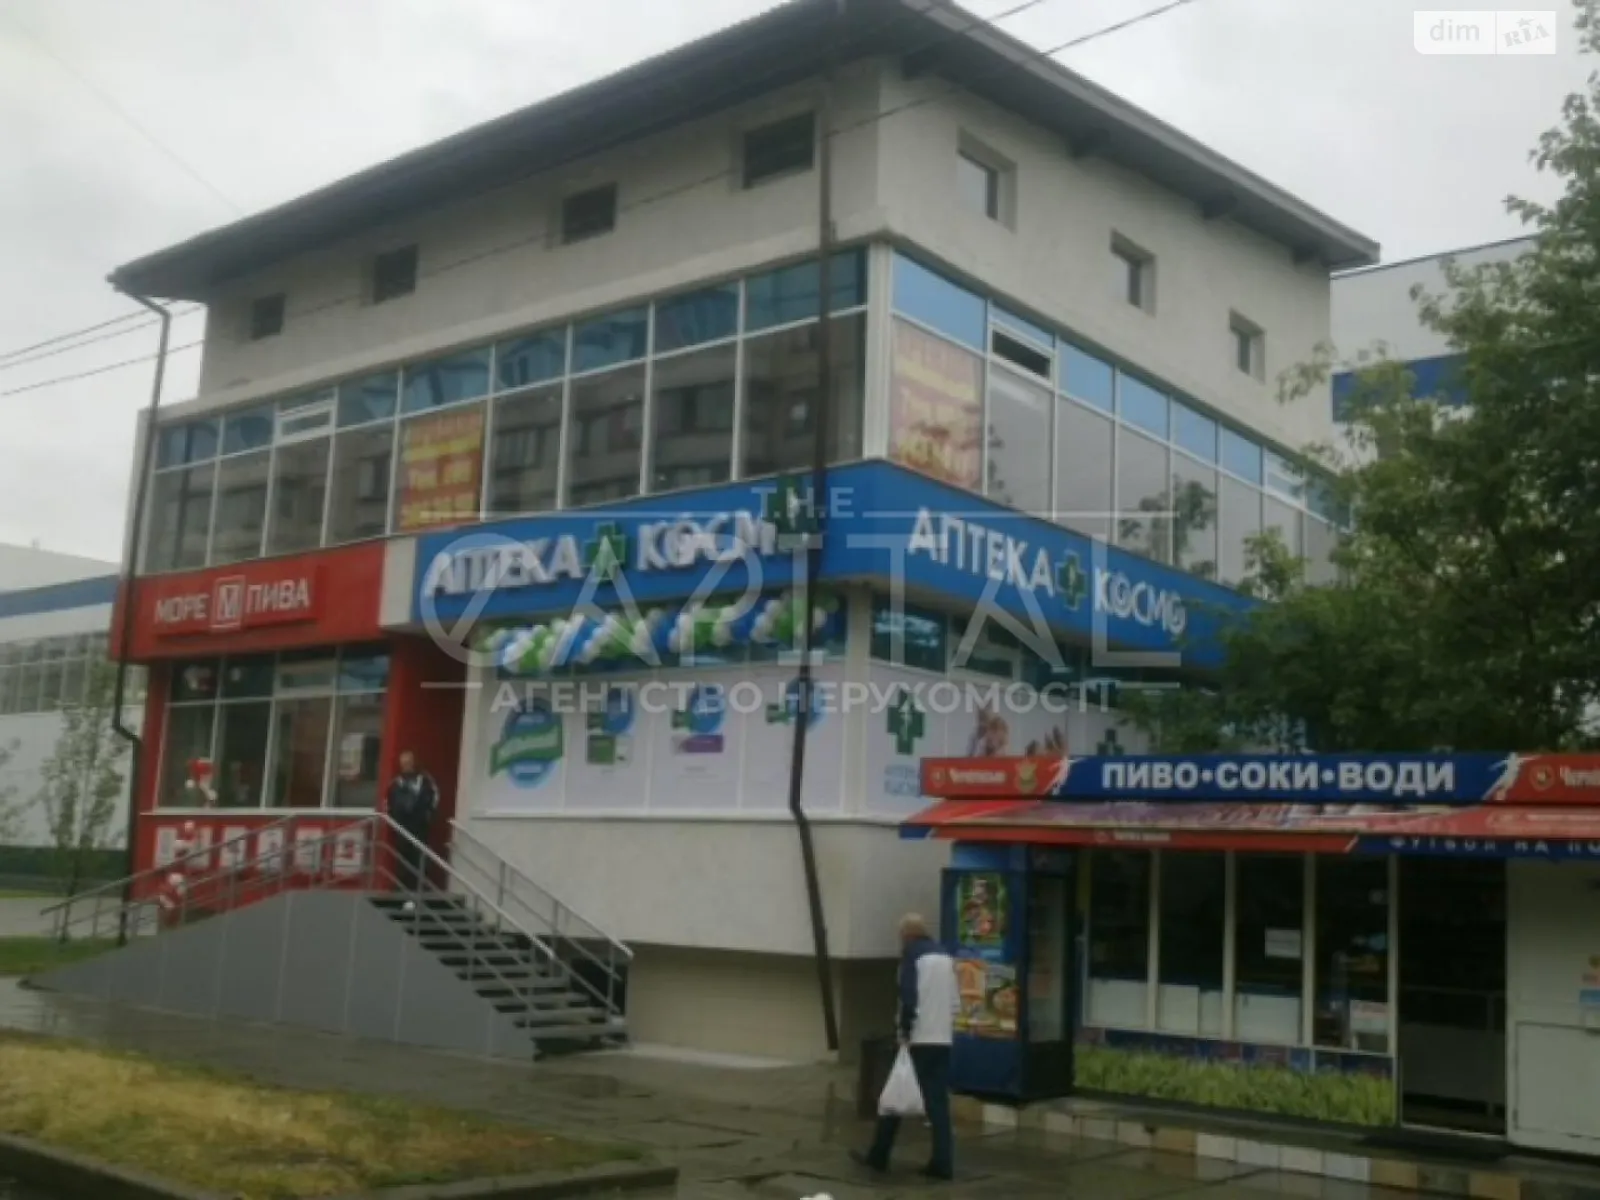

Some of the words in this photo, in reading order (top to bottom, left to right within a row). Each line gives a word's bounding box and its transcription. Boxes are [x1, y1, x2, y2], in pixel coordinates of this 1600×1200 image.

[424, 533, 582, 597] АПТЕКА
[636, 508, 778, 571] КОСМ
[908, 507, 1055, 598] АПТЕКА
[1094, 567, 1188, 635] КОСМО
[154, 593, 211, 624] МОРЕ
[245, 576, 311, 614] ПИВА
[1101, 761, 1198, 790] ПИВО
[1215, 760, 1319, 791] СОКИ
[1337, 761, 1456, 797] ВОДИ
